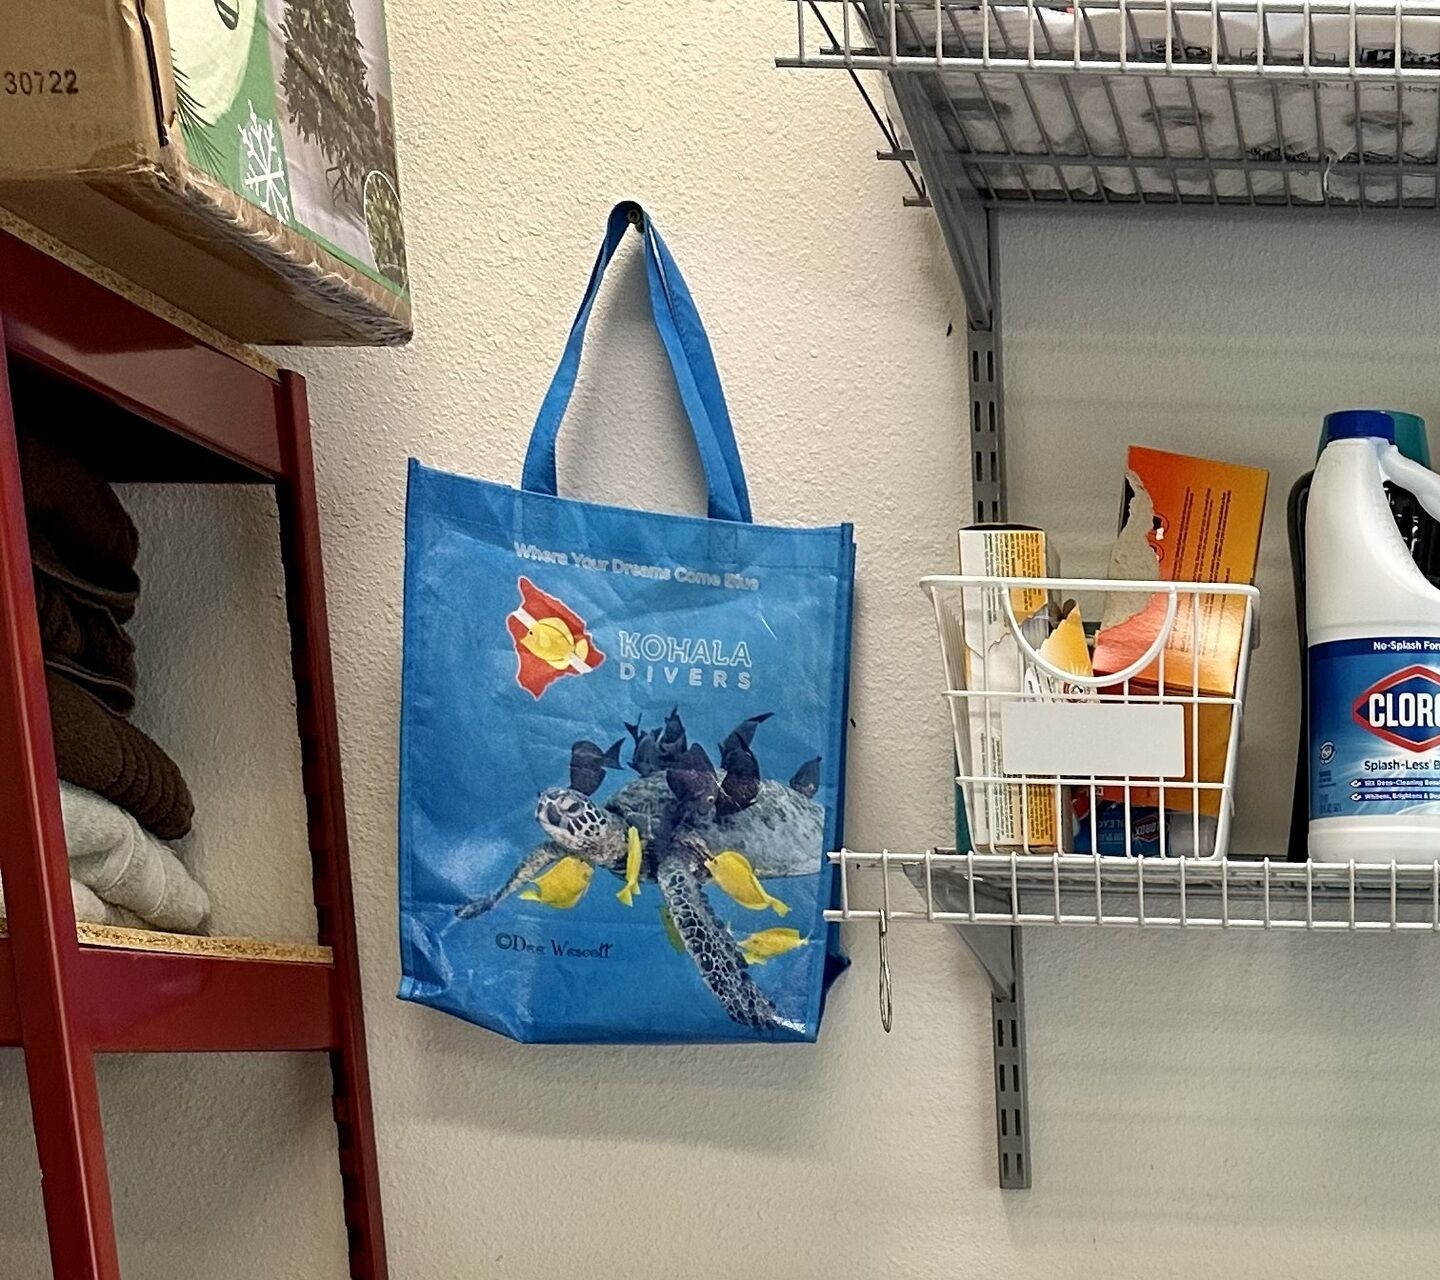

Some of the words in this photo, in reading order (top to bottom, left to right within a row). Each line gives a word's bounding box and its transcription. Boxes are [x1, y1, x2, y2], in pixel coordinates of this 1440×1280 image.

[4, 68, 79, 95] 30722
[514, 541, 567, 566] Where
[571, 551, 609, 572] Your
[612, 558, 671, 581] Dreams
[675, 566, 721, 587] Come
[619, 630, 752, 667] KOHALA
[1373, 641, 1422, 652] No-Splash
[619, 661, 751, 690] DIVERS
[1364, 759, 1430, 773] Splash-Less
